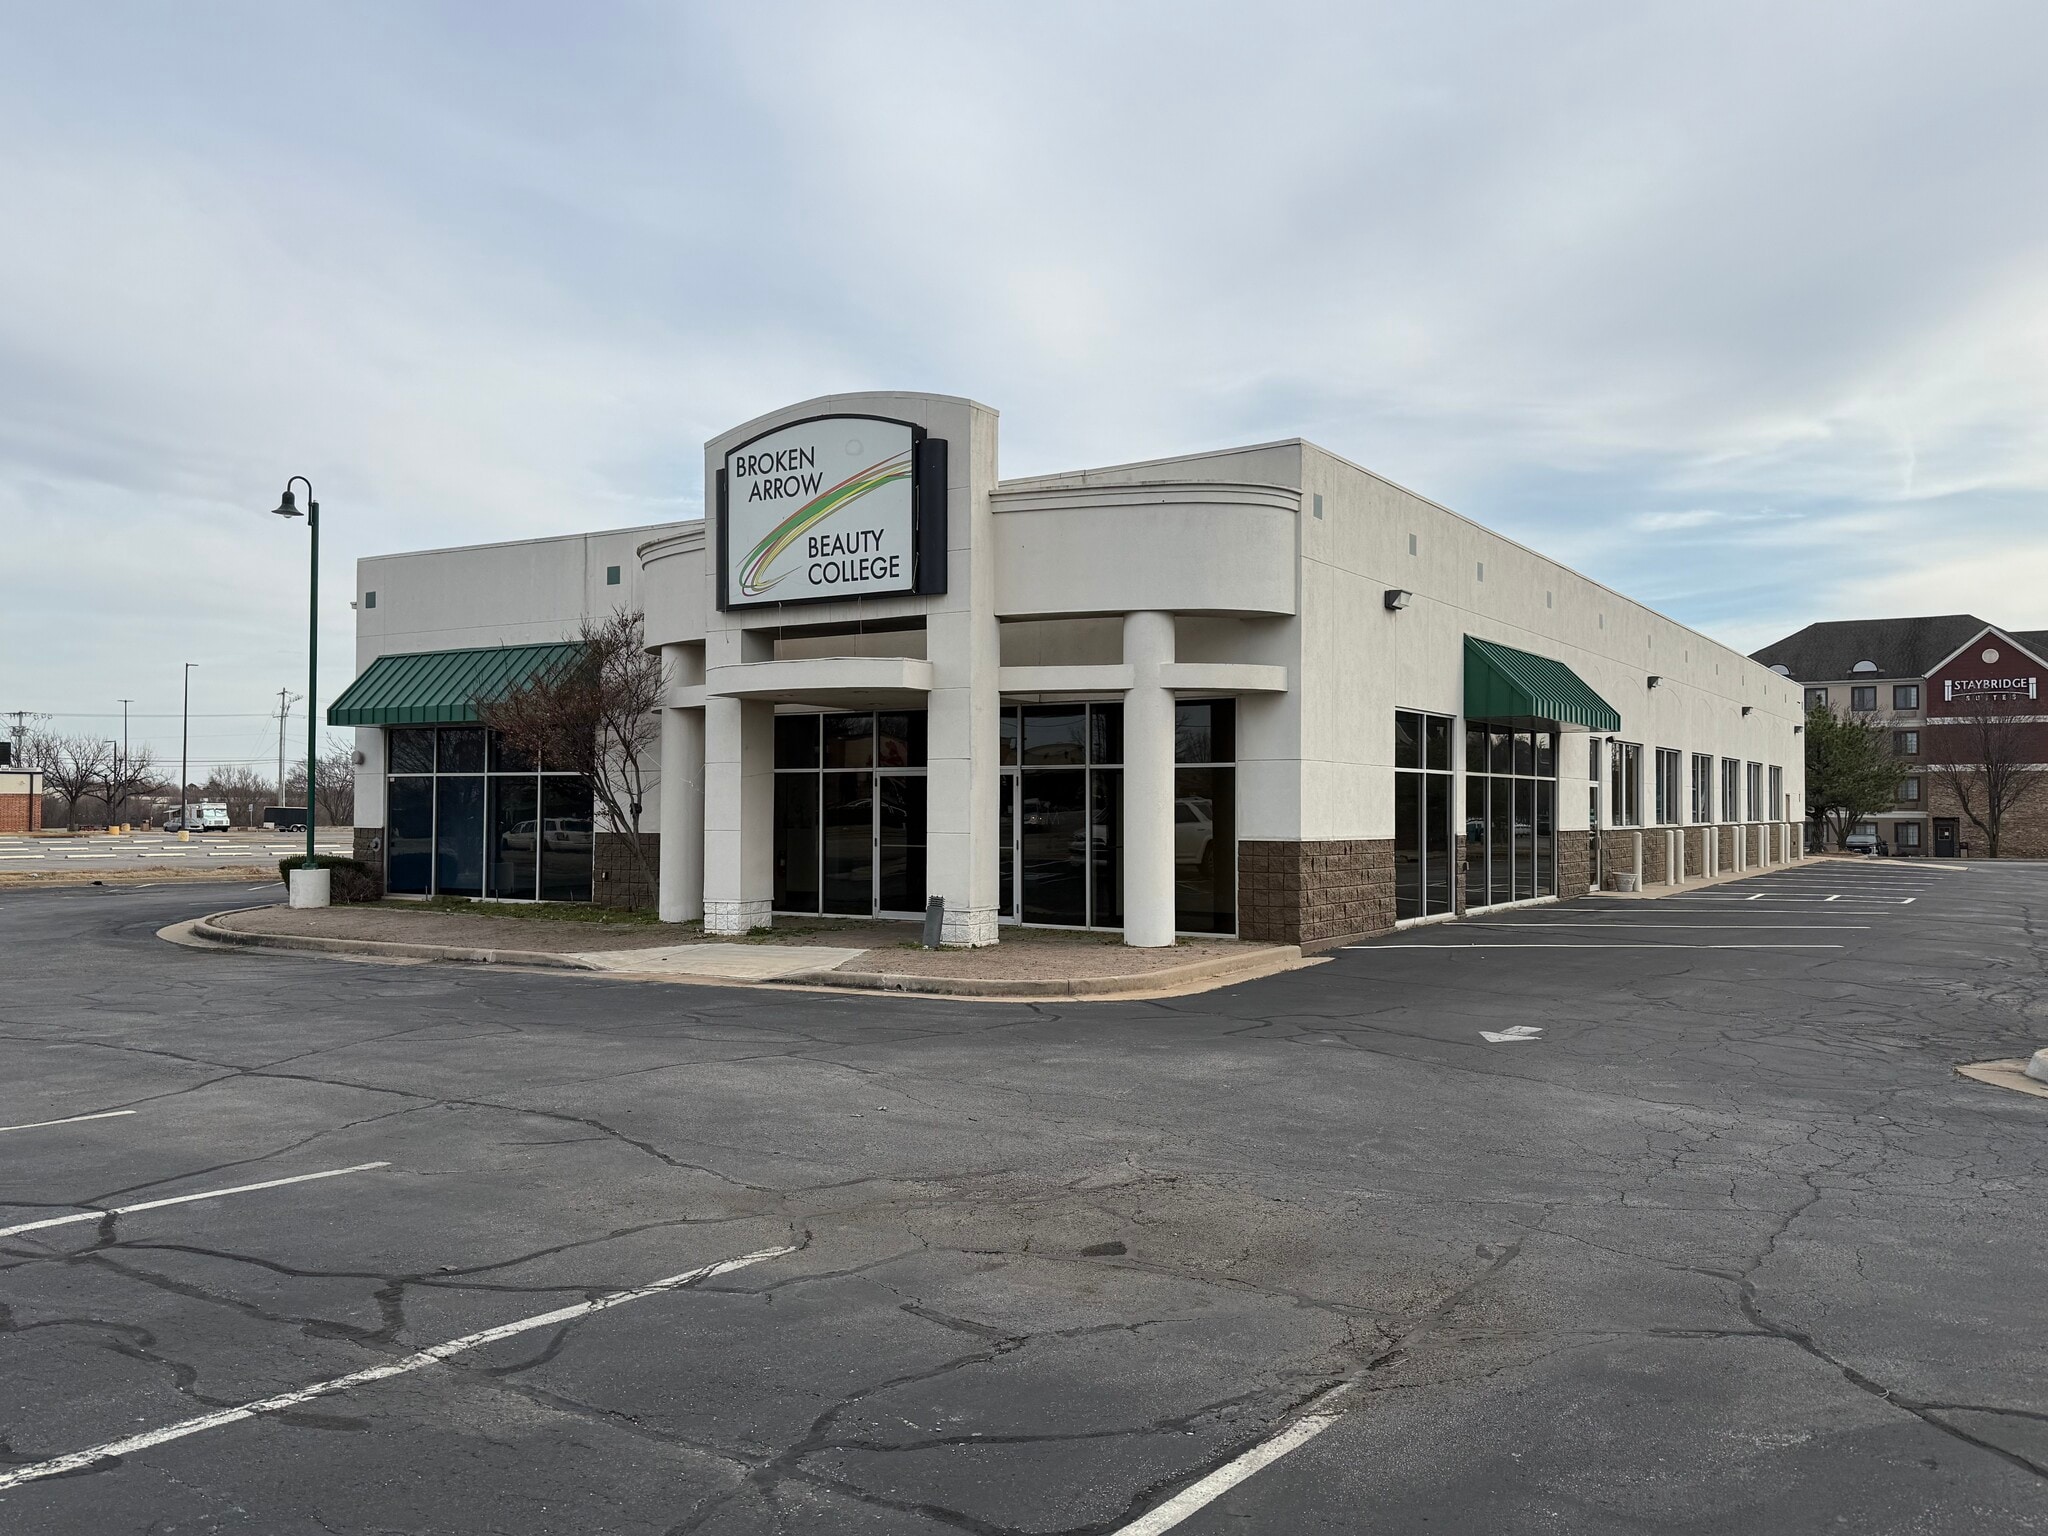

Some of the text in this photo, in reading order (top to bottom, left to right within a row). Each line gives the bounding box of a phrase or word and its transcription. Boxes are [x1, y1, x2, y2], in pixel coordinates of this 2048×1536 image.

[736, 446, 815, 477] BROKEN
[748, 472, 823, 502] ARROW
[808, 529, 884, 558] BEAUTY
[808, 555, 899, 585] COLLEGE
[1954, 679, 2028, 690] STAYBRIDGE
